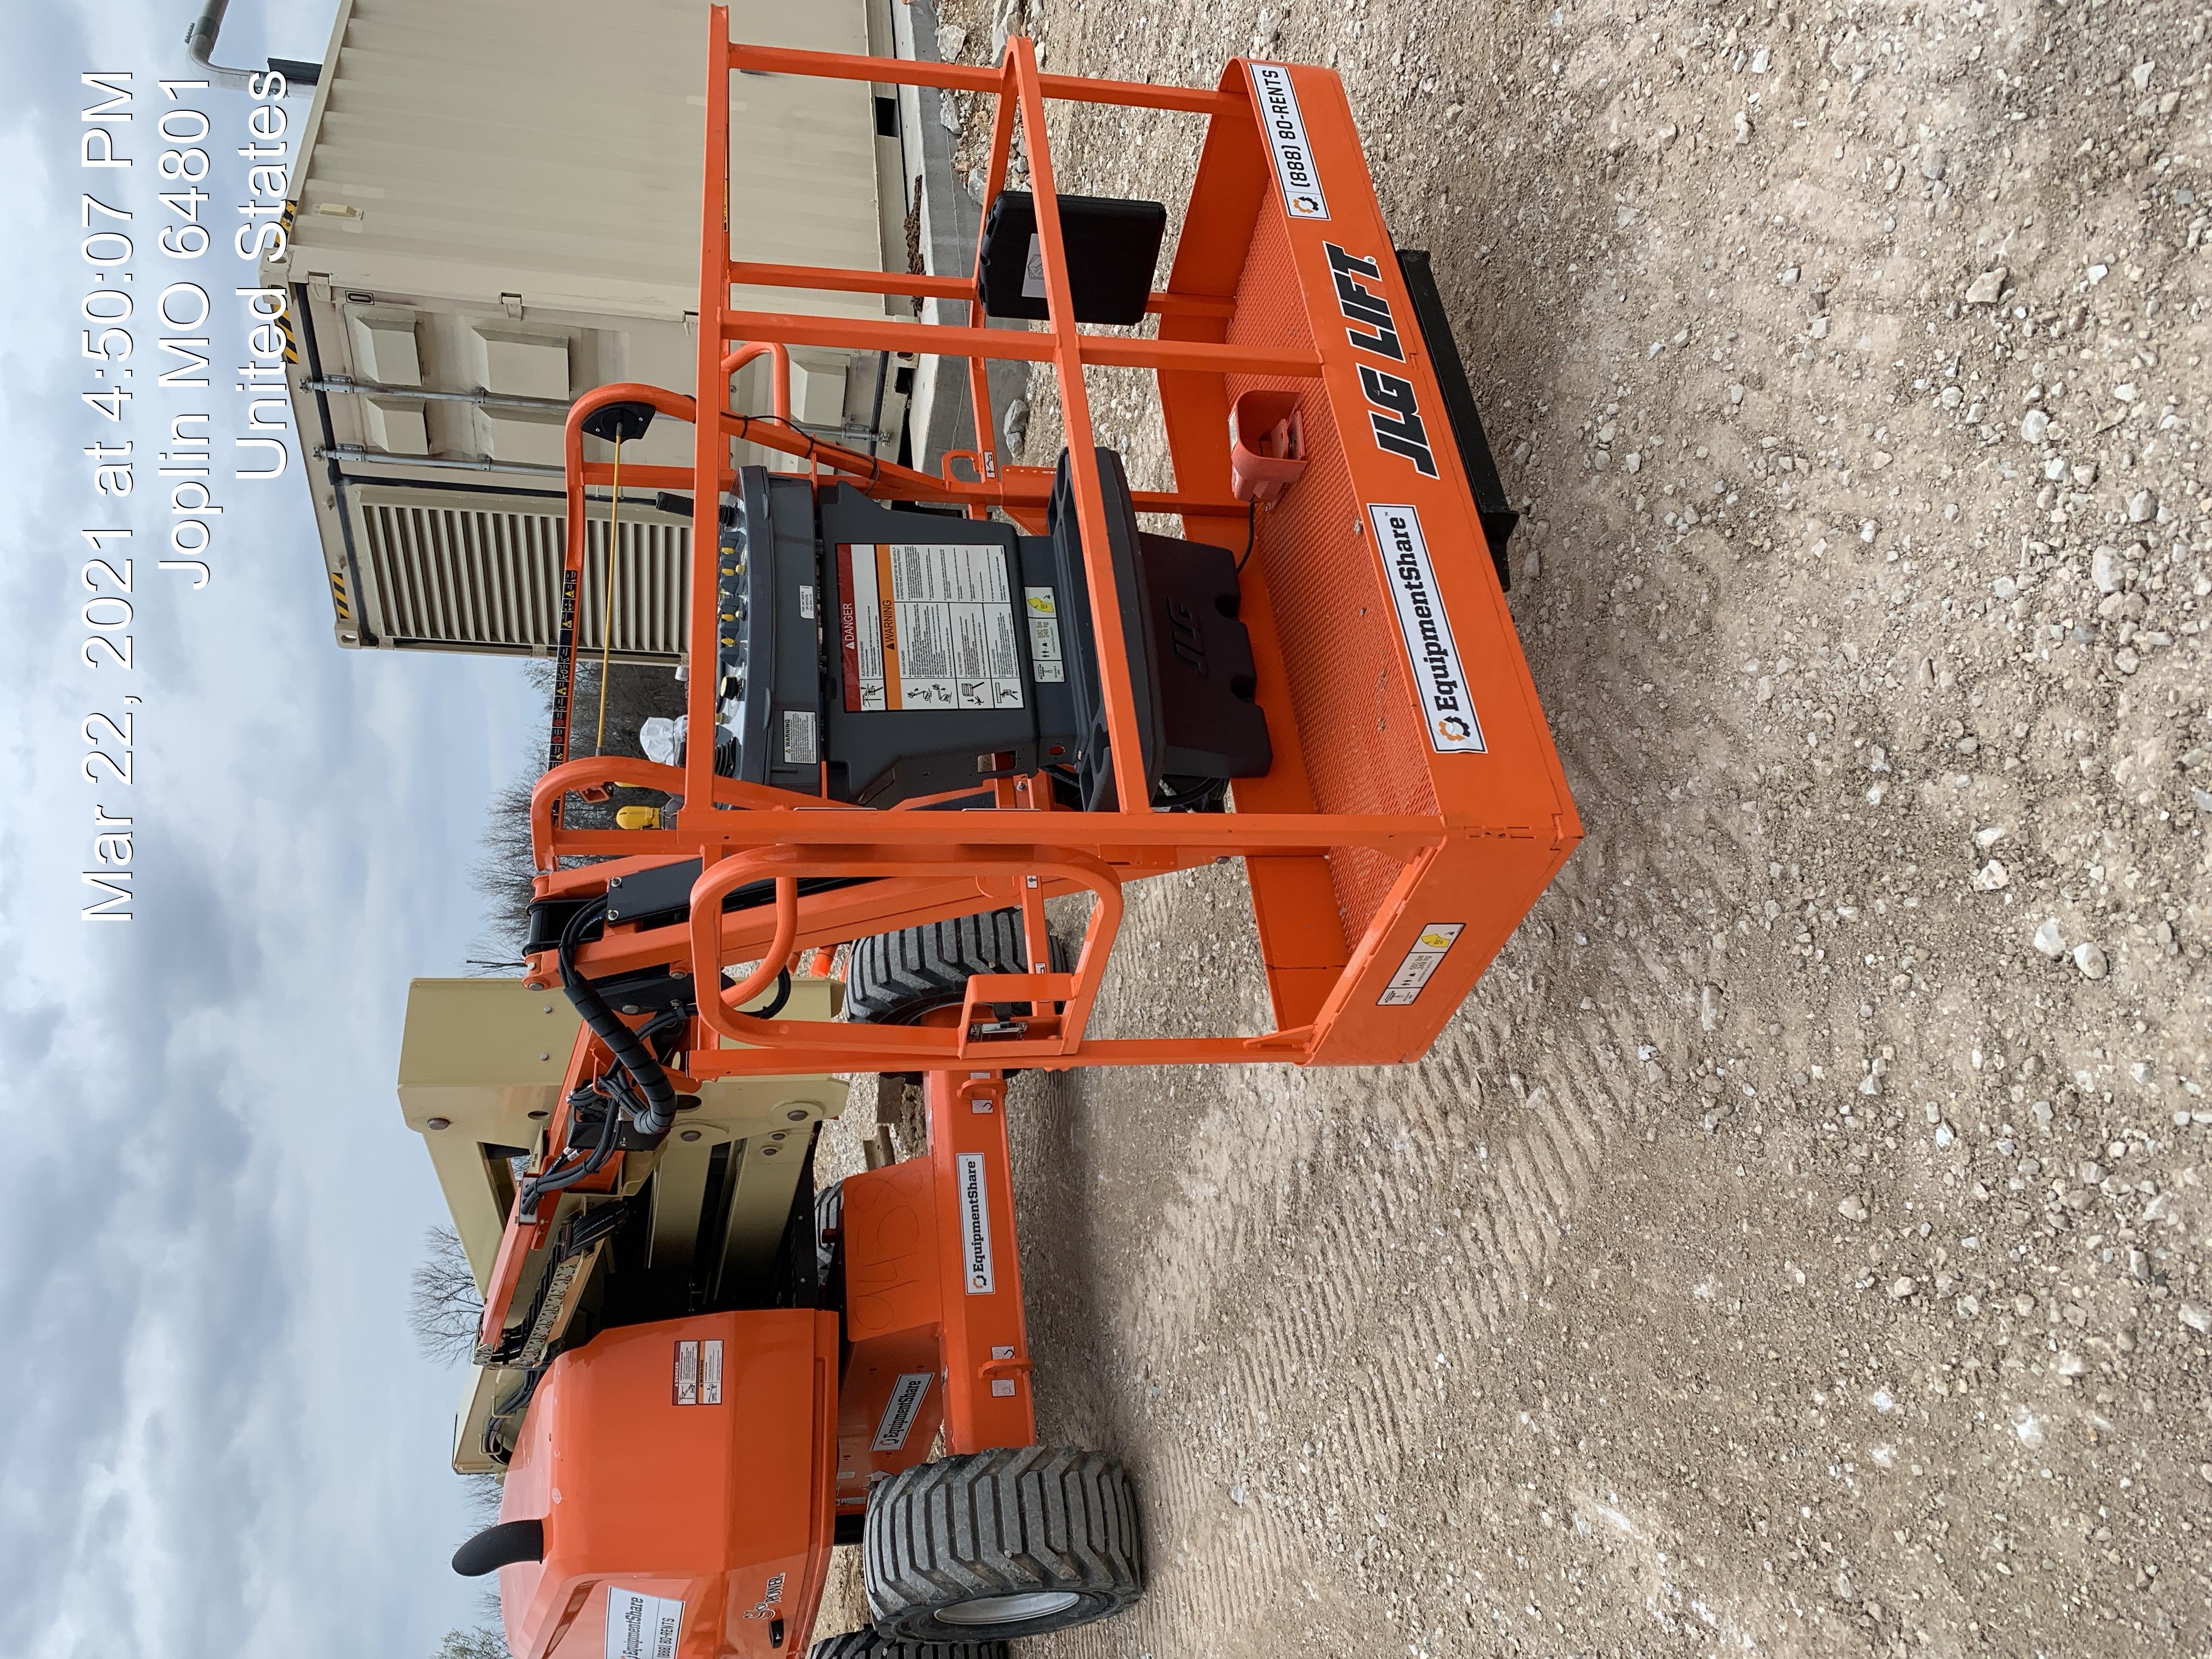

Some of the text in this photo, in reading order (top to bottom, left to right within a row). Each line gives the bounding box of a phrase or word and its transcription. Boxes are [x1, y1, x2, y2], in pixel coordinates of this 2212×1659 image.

[1262, 70, 1311, 187] (888) 80-RENTS
[1323, 241, 1440, 479] JLG LIFT
[843, 603, 854, 640] DANGER
[882, 600, 894, 642] WARNING
[1389, 517, 1459, 712] EquipmentShare
[1417, 961, 1427, 969] 249
[967, 1161, 984, 1273] EquipmentShare
[852, 1168, 923, 1330] 9458
[883, 1381, 921, 1438] EquipmentShare
[765, 1575, 785, 1602] POWER
[623, 1597, 643, 1656] EquipmentShare
[657, 1618, 674, 1658] (888) 80-RENTS
